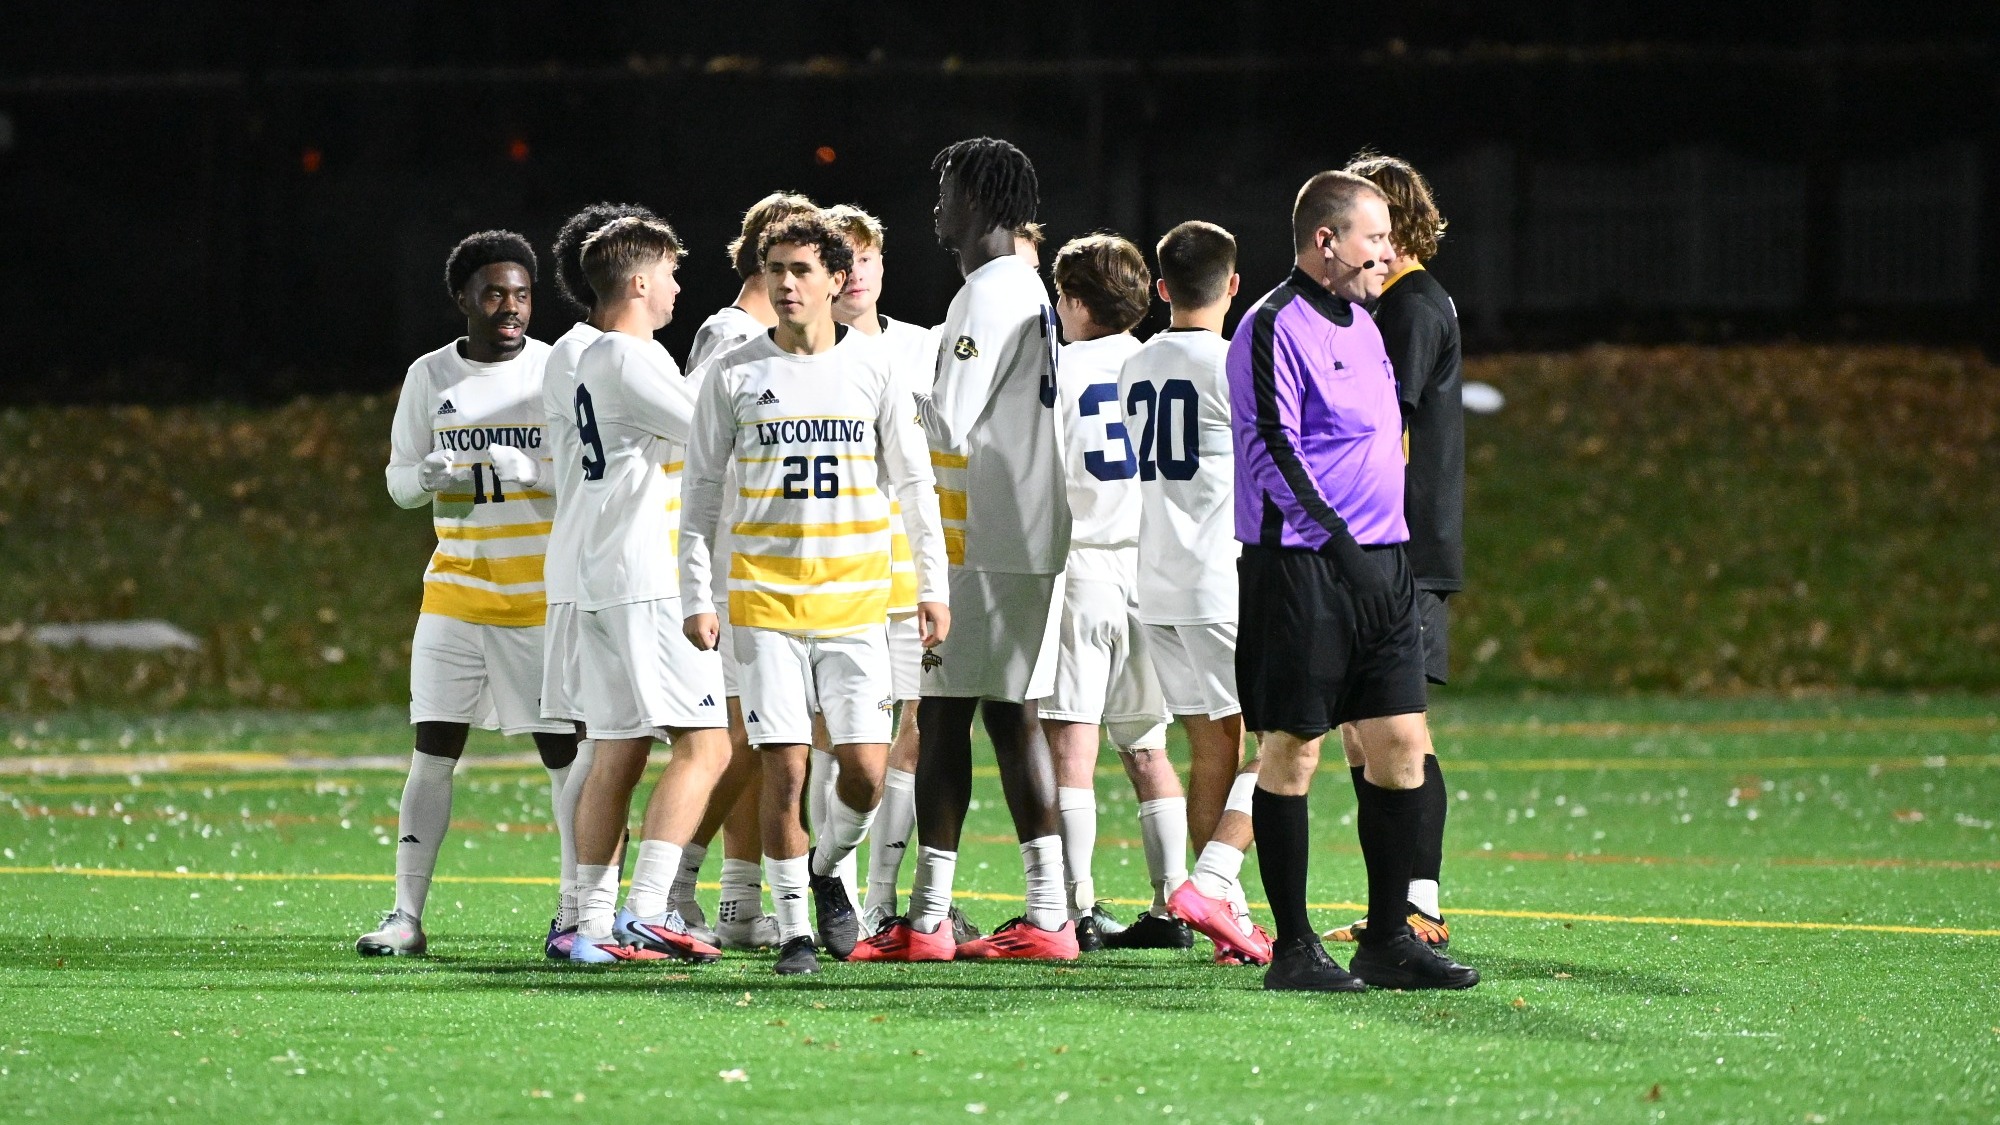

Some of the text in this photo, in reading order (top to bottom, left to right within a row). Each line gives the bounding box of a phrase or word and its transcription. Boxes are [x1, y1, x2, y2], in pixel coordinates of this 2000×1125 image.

[439, 427, 542, 451] LYCOMING
[756, 419, 864, 445] LYCOMING
[1078, 383, 1138, 481] 3
[1127, 379, 1199, 481] 20
[471, 463, 505, 504] 11
[783, 455, 839, 499] 26
